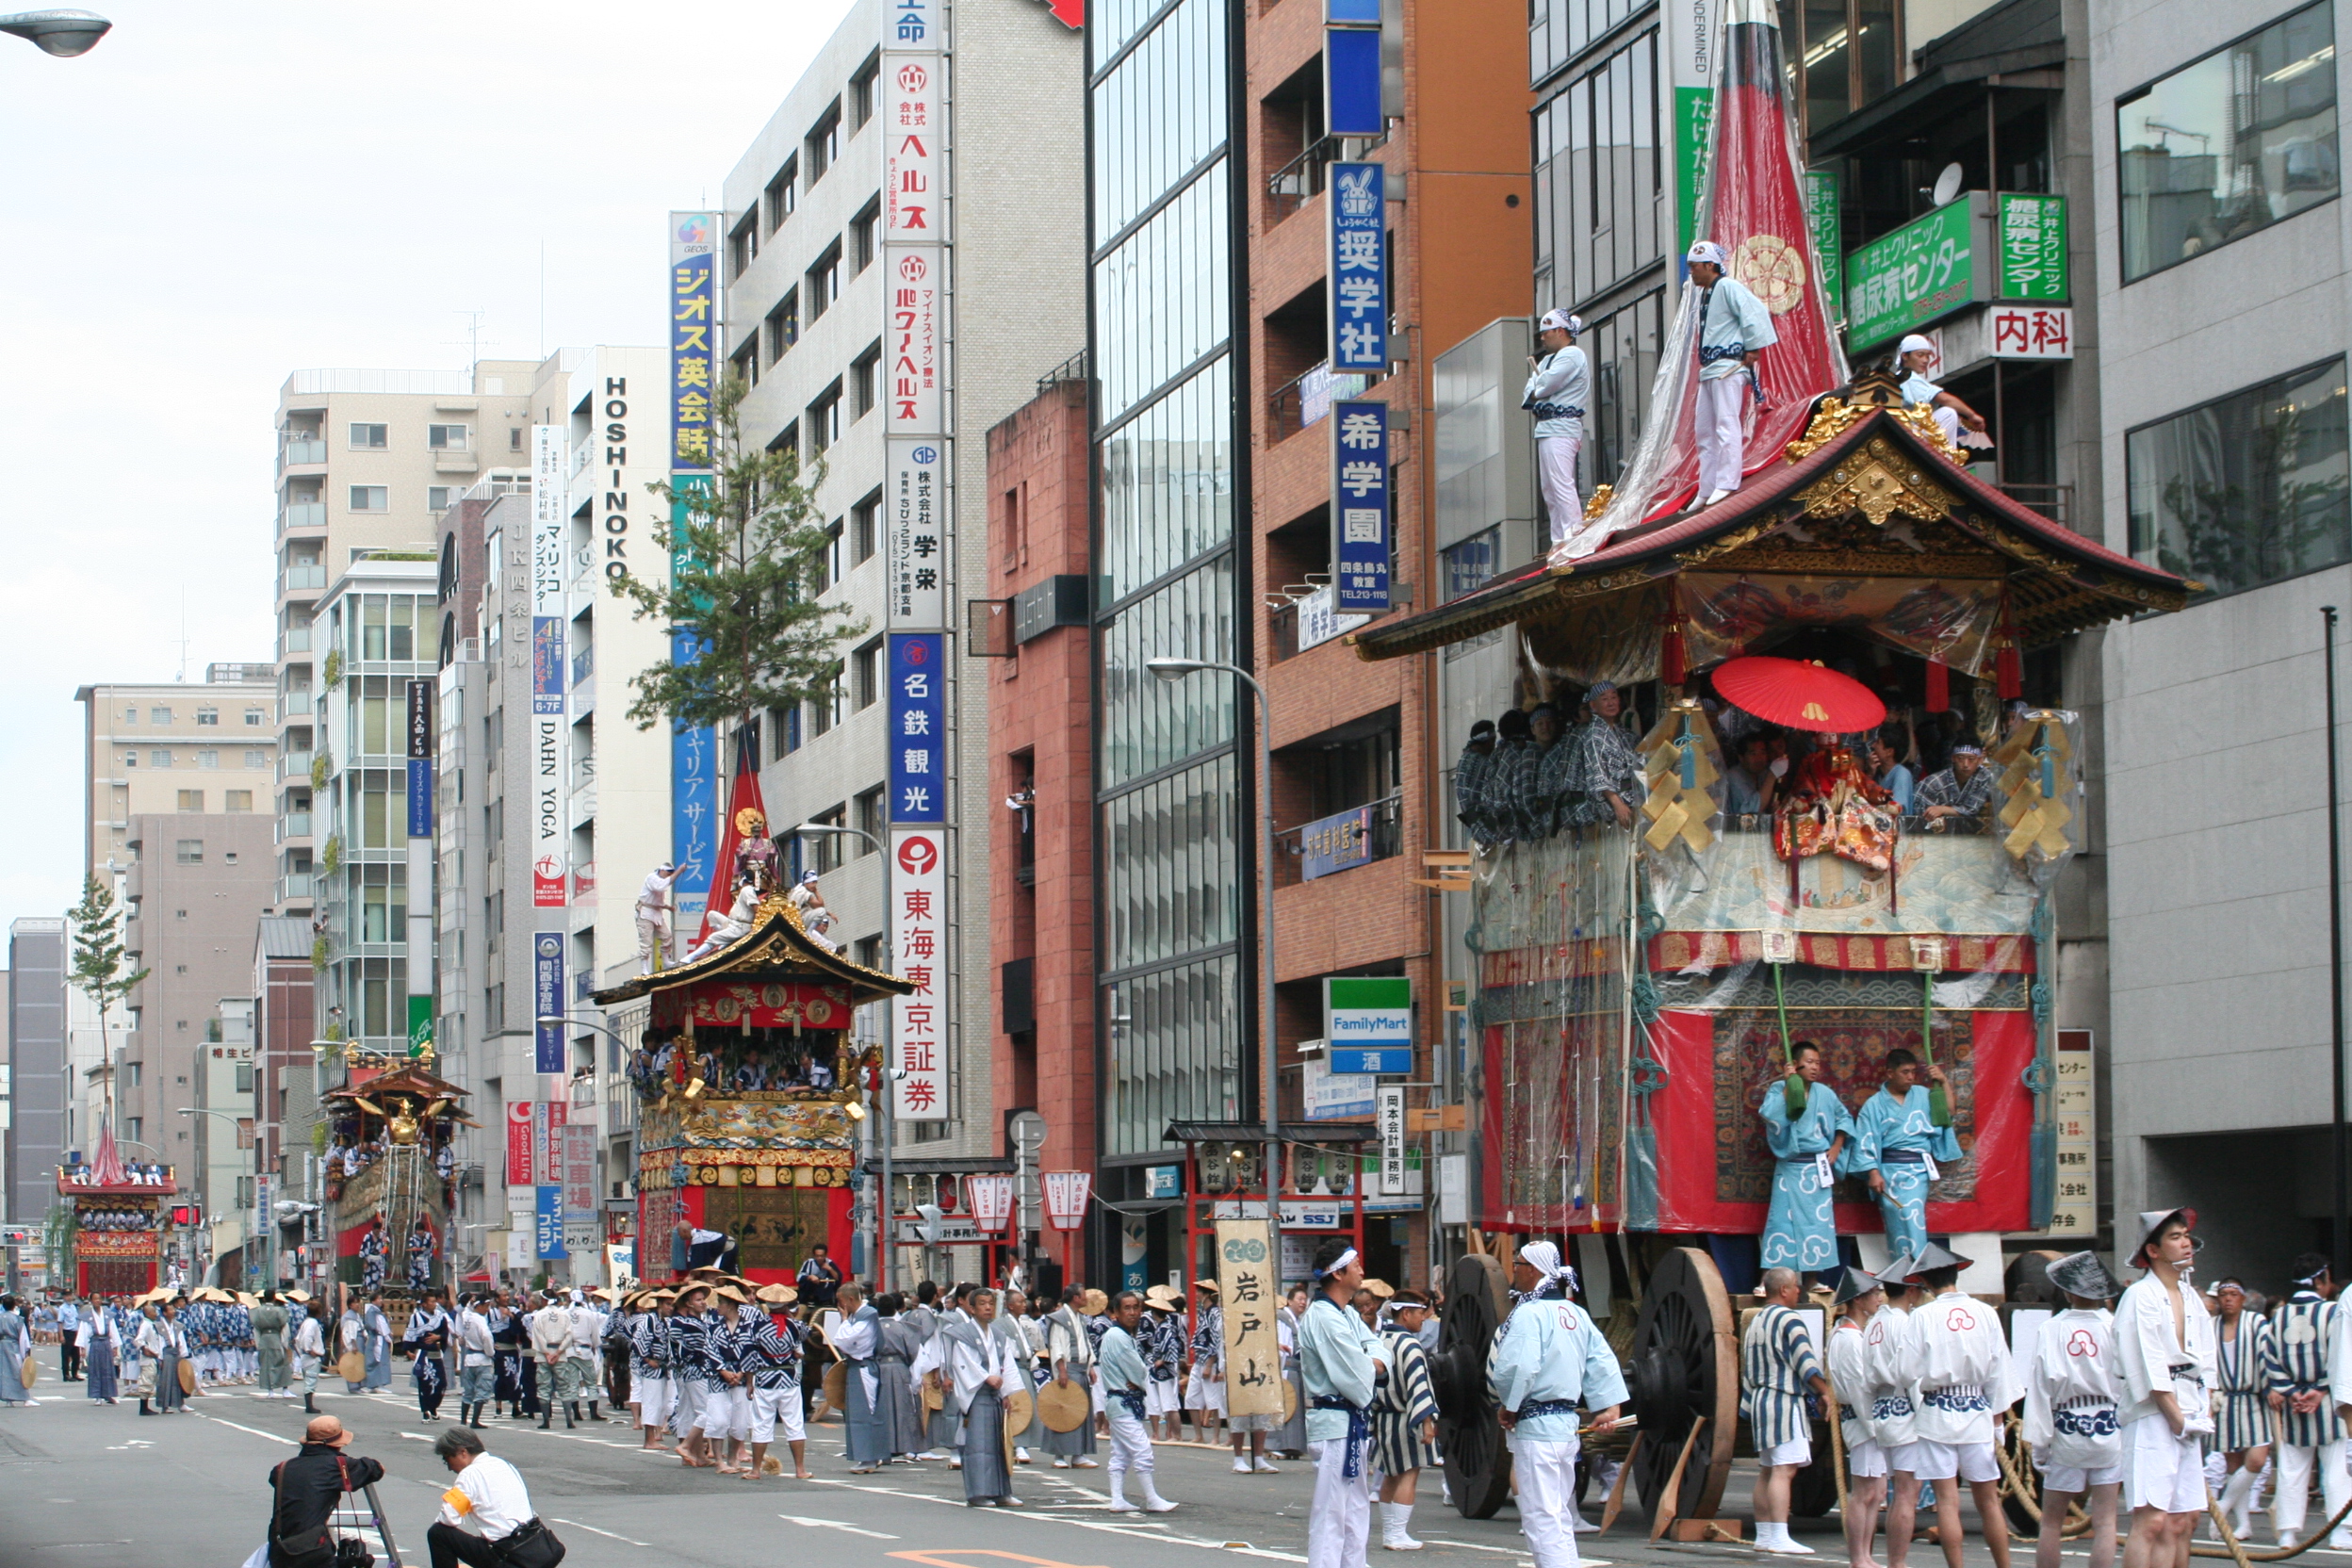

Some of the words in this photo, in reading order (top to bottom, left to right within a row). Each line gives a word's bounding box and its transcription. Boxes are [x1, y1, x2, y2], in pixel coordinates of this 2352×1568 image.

[896, 0, 927, 43] 命
[899, 101, 926, 126] 株式会社
[900, 135, 927, 229] ヘルス
[683, 245, 708, 253] GEOS
[1821, 190, 1836, 281] 井上クリニック
[1870, 215, 1944, 272] 井上クリニック
[2005, 199, 2041, 296] 糖尿病センター
[2043, 218, 2062, 295] 井上クリニック
[1338, 230, 1381, 364] 奨学社
[1850, 237, 1970, 326] 糖尿病センター
[675, 269, 710, 458] ジオス英会話
[895, 288, 918, 419] パワーヘルス
[922, 289, 934, 389] マイナスイオン療法
[1995, 310, 2068, 354] 内科
[918, 471, 931, 525] 株式会社
[1341, 413, 1383, 544] 希学園
[510, 525, 530, 669] JK四条ビル
[535, 533, 547, 613] ダンスシアター
[900, 572, 911, 616] 京都支局
[913, 534, 938, 591] 学栄
[1352, 576, 1376, 588] 教室
[541, 721, 557, 776] DAHN
[904, 673, 930, 812] 名鉄観光
[541, 787, 557, 841] YOGA
[682, 801, 707, 882] サービス
[903, 889, 936, 1112] 東海東京証券
[1333, 1017, 1408, 1033] FamilyMart
[1362, 1052, 1381, 1071] 酒
[567, 1139, 593, 1209] 駐車場
[1387, 1095, 1400, 1185] 岡本会計事務所
[1303, 1214, 1335, 1224] SSJ
[1233, 1271, 1266, 1388] 岩戸山
